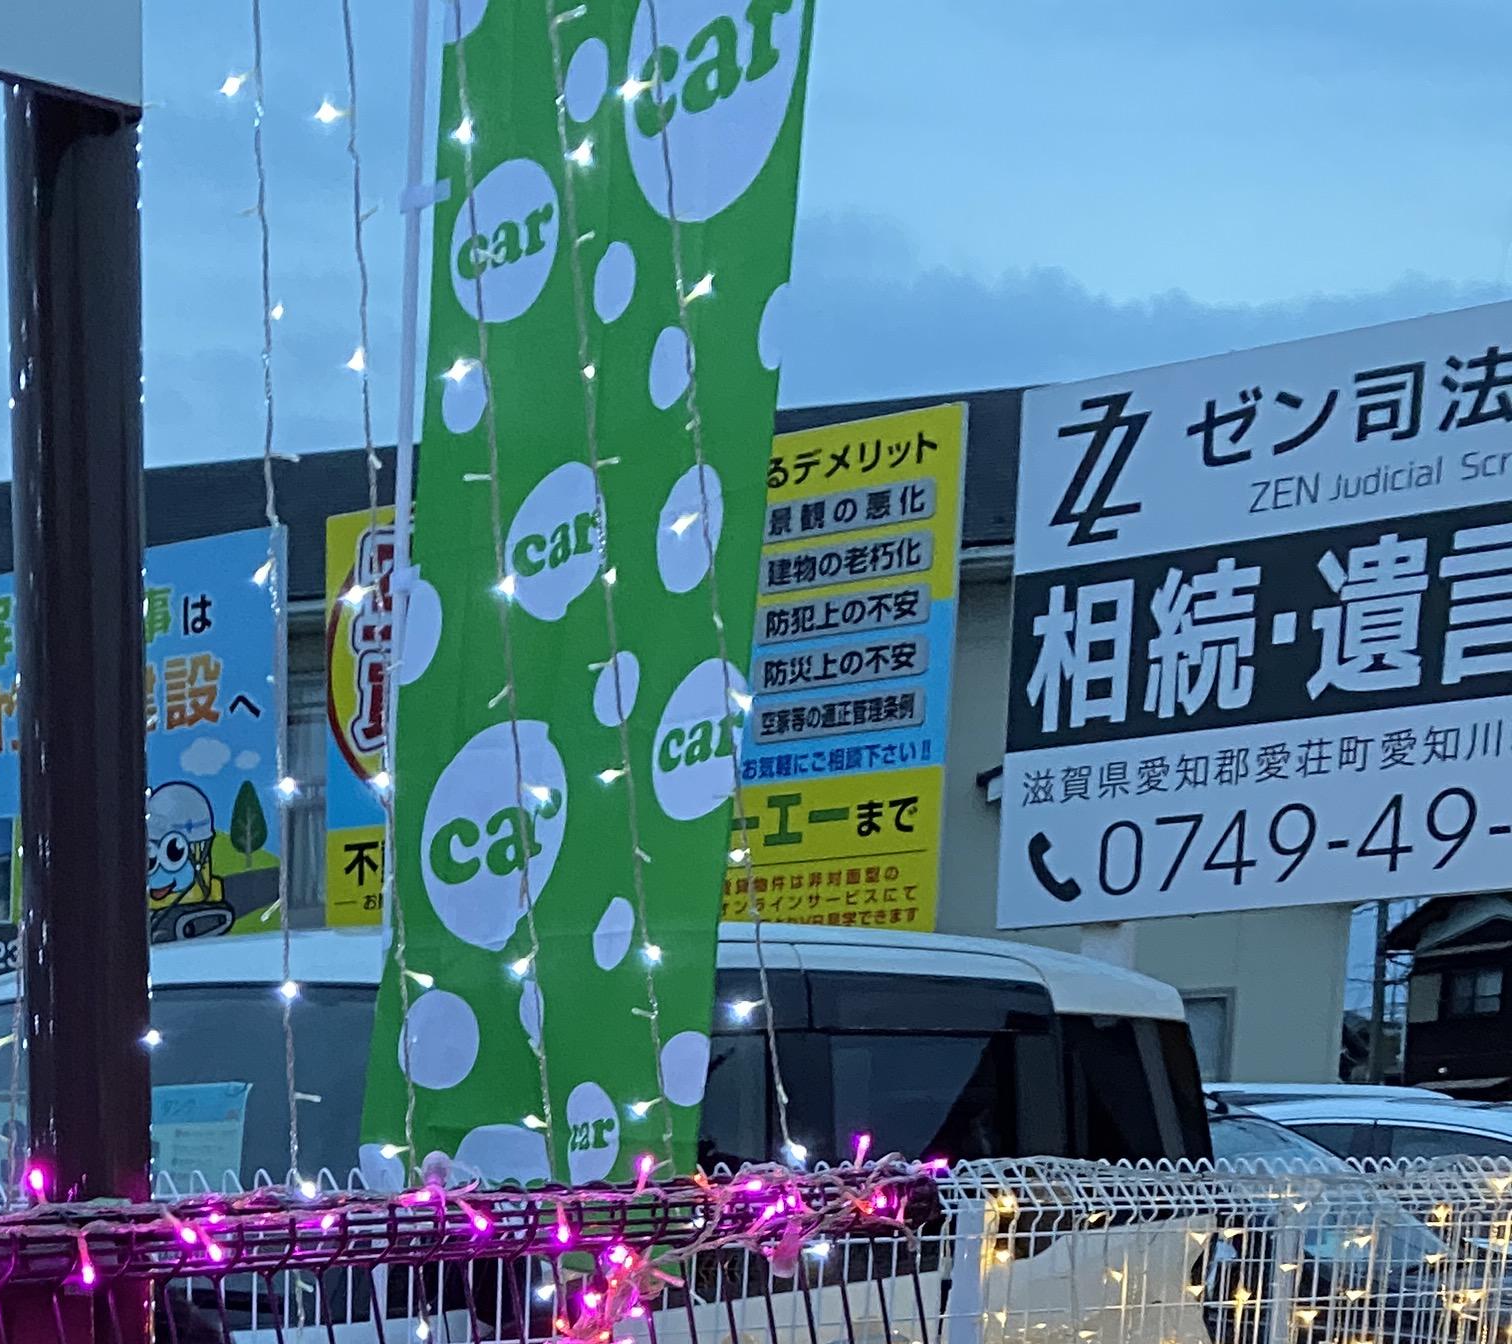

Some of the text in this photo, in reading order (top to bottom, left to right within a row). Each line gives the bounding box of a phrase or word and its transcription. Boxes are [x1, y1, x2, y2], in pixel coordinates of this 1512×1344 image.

[634, 0, 792, 138] car
[458, 203, 553, 279] car
[1186, 346, 1512, 467] ゼン司法
[767, 432, 937, 489] るデメリット
[1249, 471, 1320, 513] ZEN
[1330, 456, 1443, 500] Judicial
[769, 485, 925, 536] 景観の悪化
[513, 512, 597, 577] car
[768, 538, 921, 587] 建物の老朽化
[766, 590, 919, 638] 防犯上の不安
[764, 643, 917, 688] 防災上の不安
[659, 711, 744, 773] car
[344, 841, 385, 886] 不
